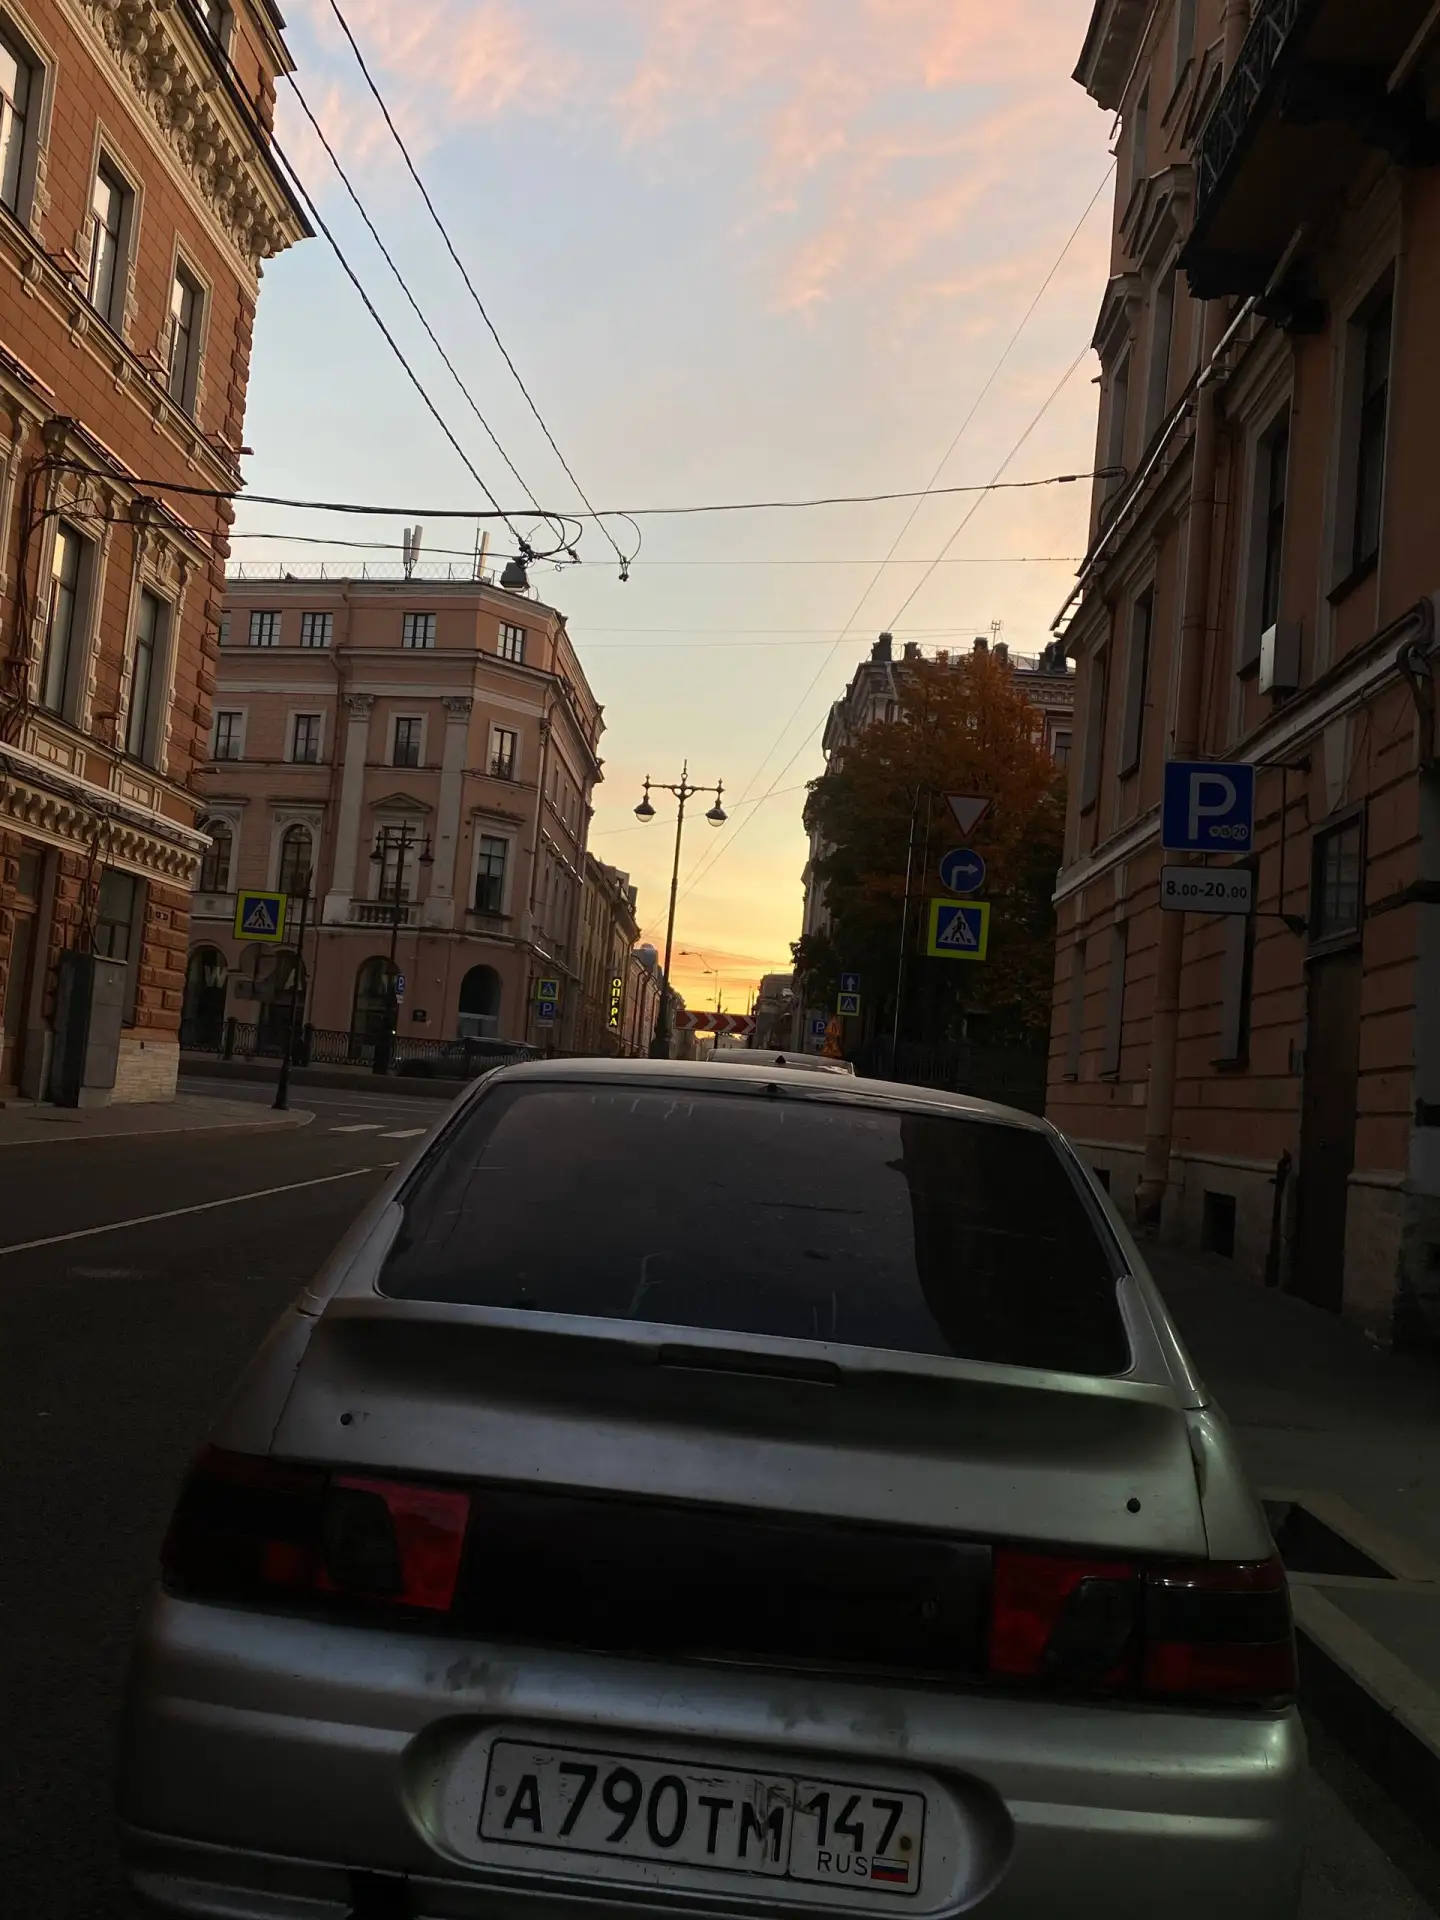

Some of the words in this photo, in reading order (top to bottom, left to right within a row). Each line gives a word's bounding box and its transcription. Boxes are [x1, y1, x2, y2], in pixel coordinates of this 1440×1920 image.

[1188, 772, 1236, 840] P
[542, 1002, 552, 1016] P
[806, 1792, 904, 1856] 147
[817, 1850, 868, 1877] RUS
